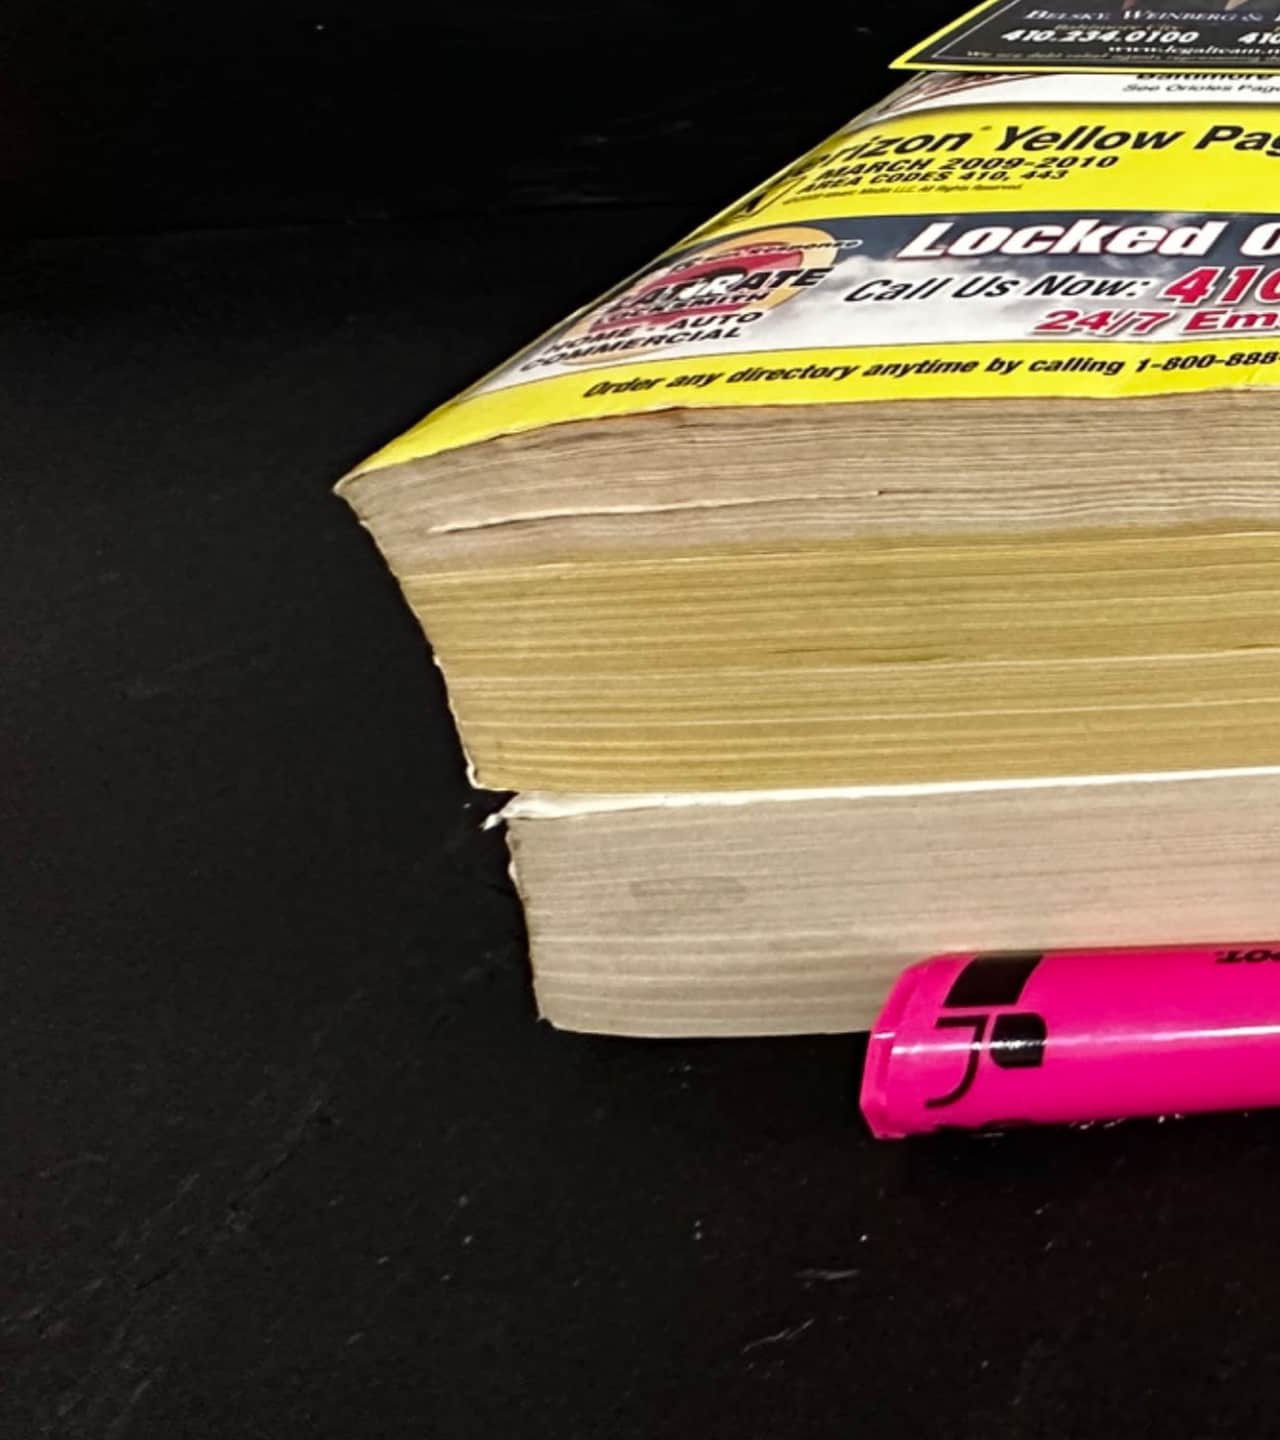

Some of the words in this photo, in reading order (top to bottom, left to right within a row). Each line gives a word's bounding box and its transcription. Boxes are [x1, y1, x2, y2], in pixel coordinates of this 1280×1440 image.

[1001, 28, 1201, 44] 410.234.0100
[995, 125, 1186, 152] Yellow
[816, 157, 935, 180] MARCH
[938, 155, 1119, 170] 2009-2010
[870, 170, 953, 184] CODES
[959, 170, 1009, 182] 410,
[1020, 169, 1069, 181] 443
[896, 218, 1230, 259] Locked
[843, 276, 953, 302] Call
[952, 274, 1019, 299] Us
[1025, 274, 1151, 299] Now:
[659, 312, 764, 330] AUTO
[1032, 310, 1172, 335] 24/7
[582, 377, 665, 398] Order
[666, 372, 720, 388] any
[725, 364, 859, 384] directory
[862, 359, 976, 379] anytime
[984, 356, 1023, 375] by
[1028, 356, 1126, 376] calling
